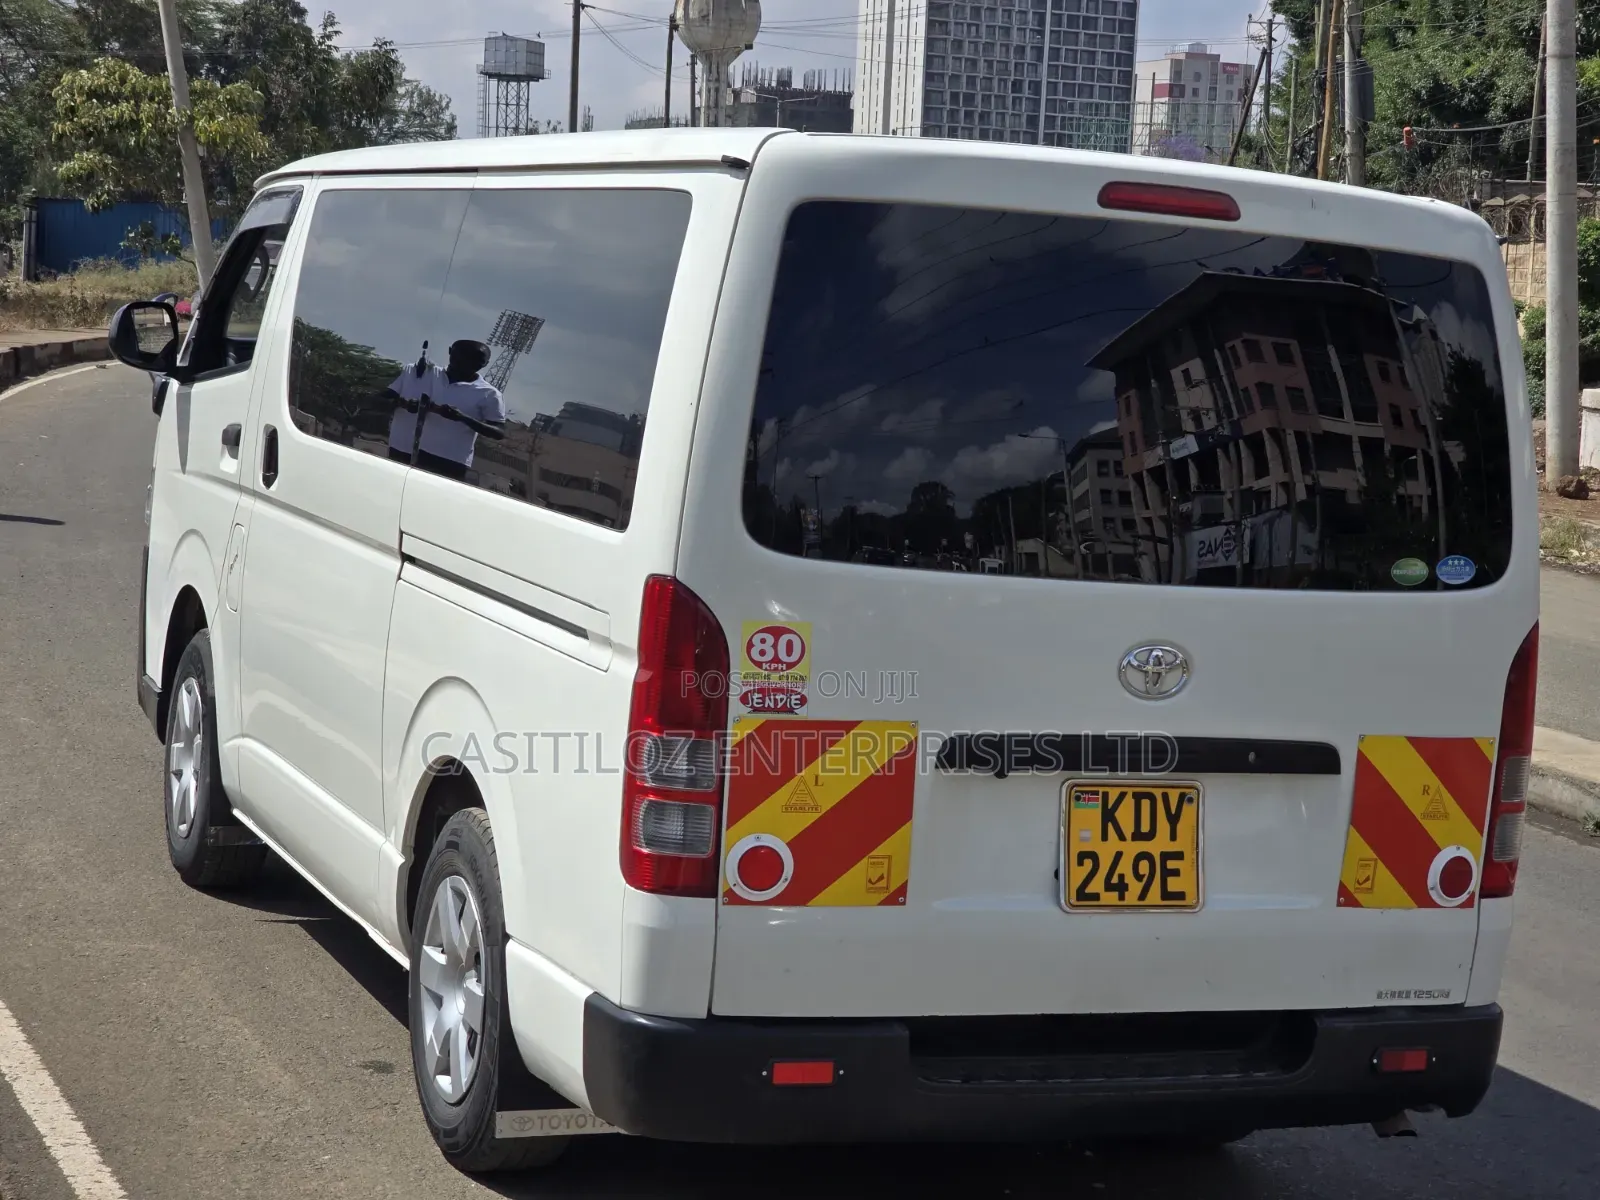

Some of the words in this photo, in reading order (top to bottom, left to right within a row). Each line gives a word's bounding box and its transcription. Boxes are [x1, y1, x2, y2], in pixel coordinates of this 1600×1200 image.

[750, 632, 802, 663] 80
[762, 662, 787, 671] KPH
[745, 692, 802, 709] JENDIE
[813, 774, 824, 787] L
[1421, 784, 1431, 796] R
[1100, 791, 1187, 842] KDY
[1076, 850, 1186, 902] 249E
